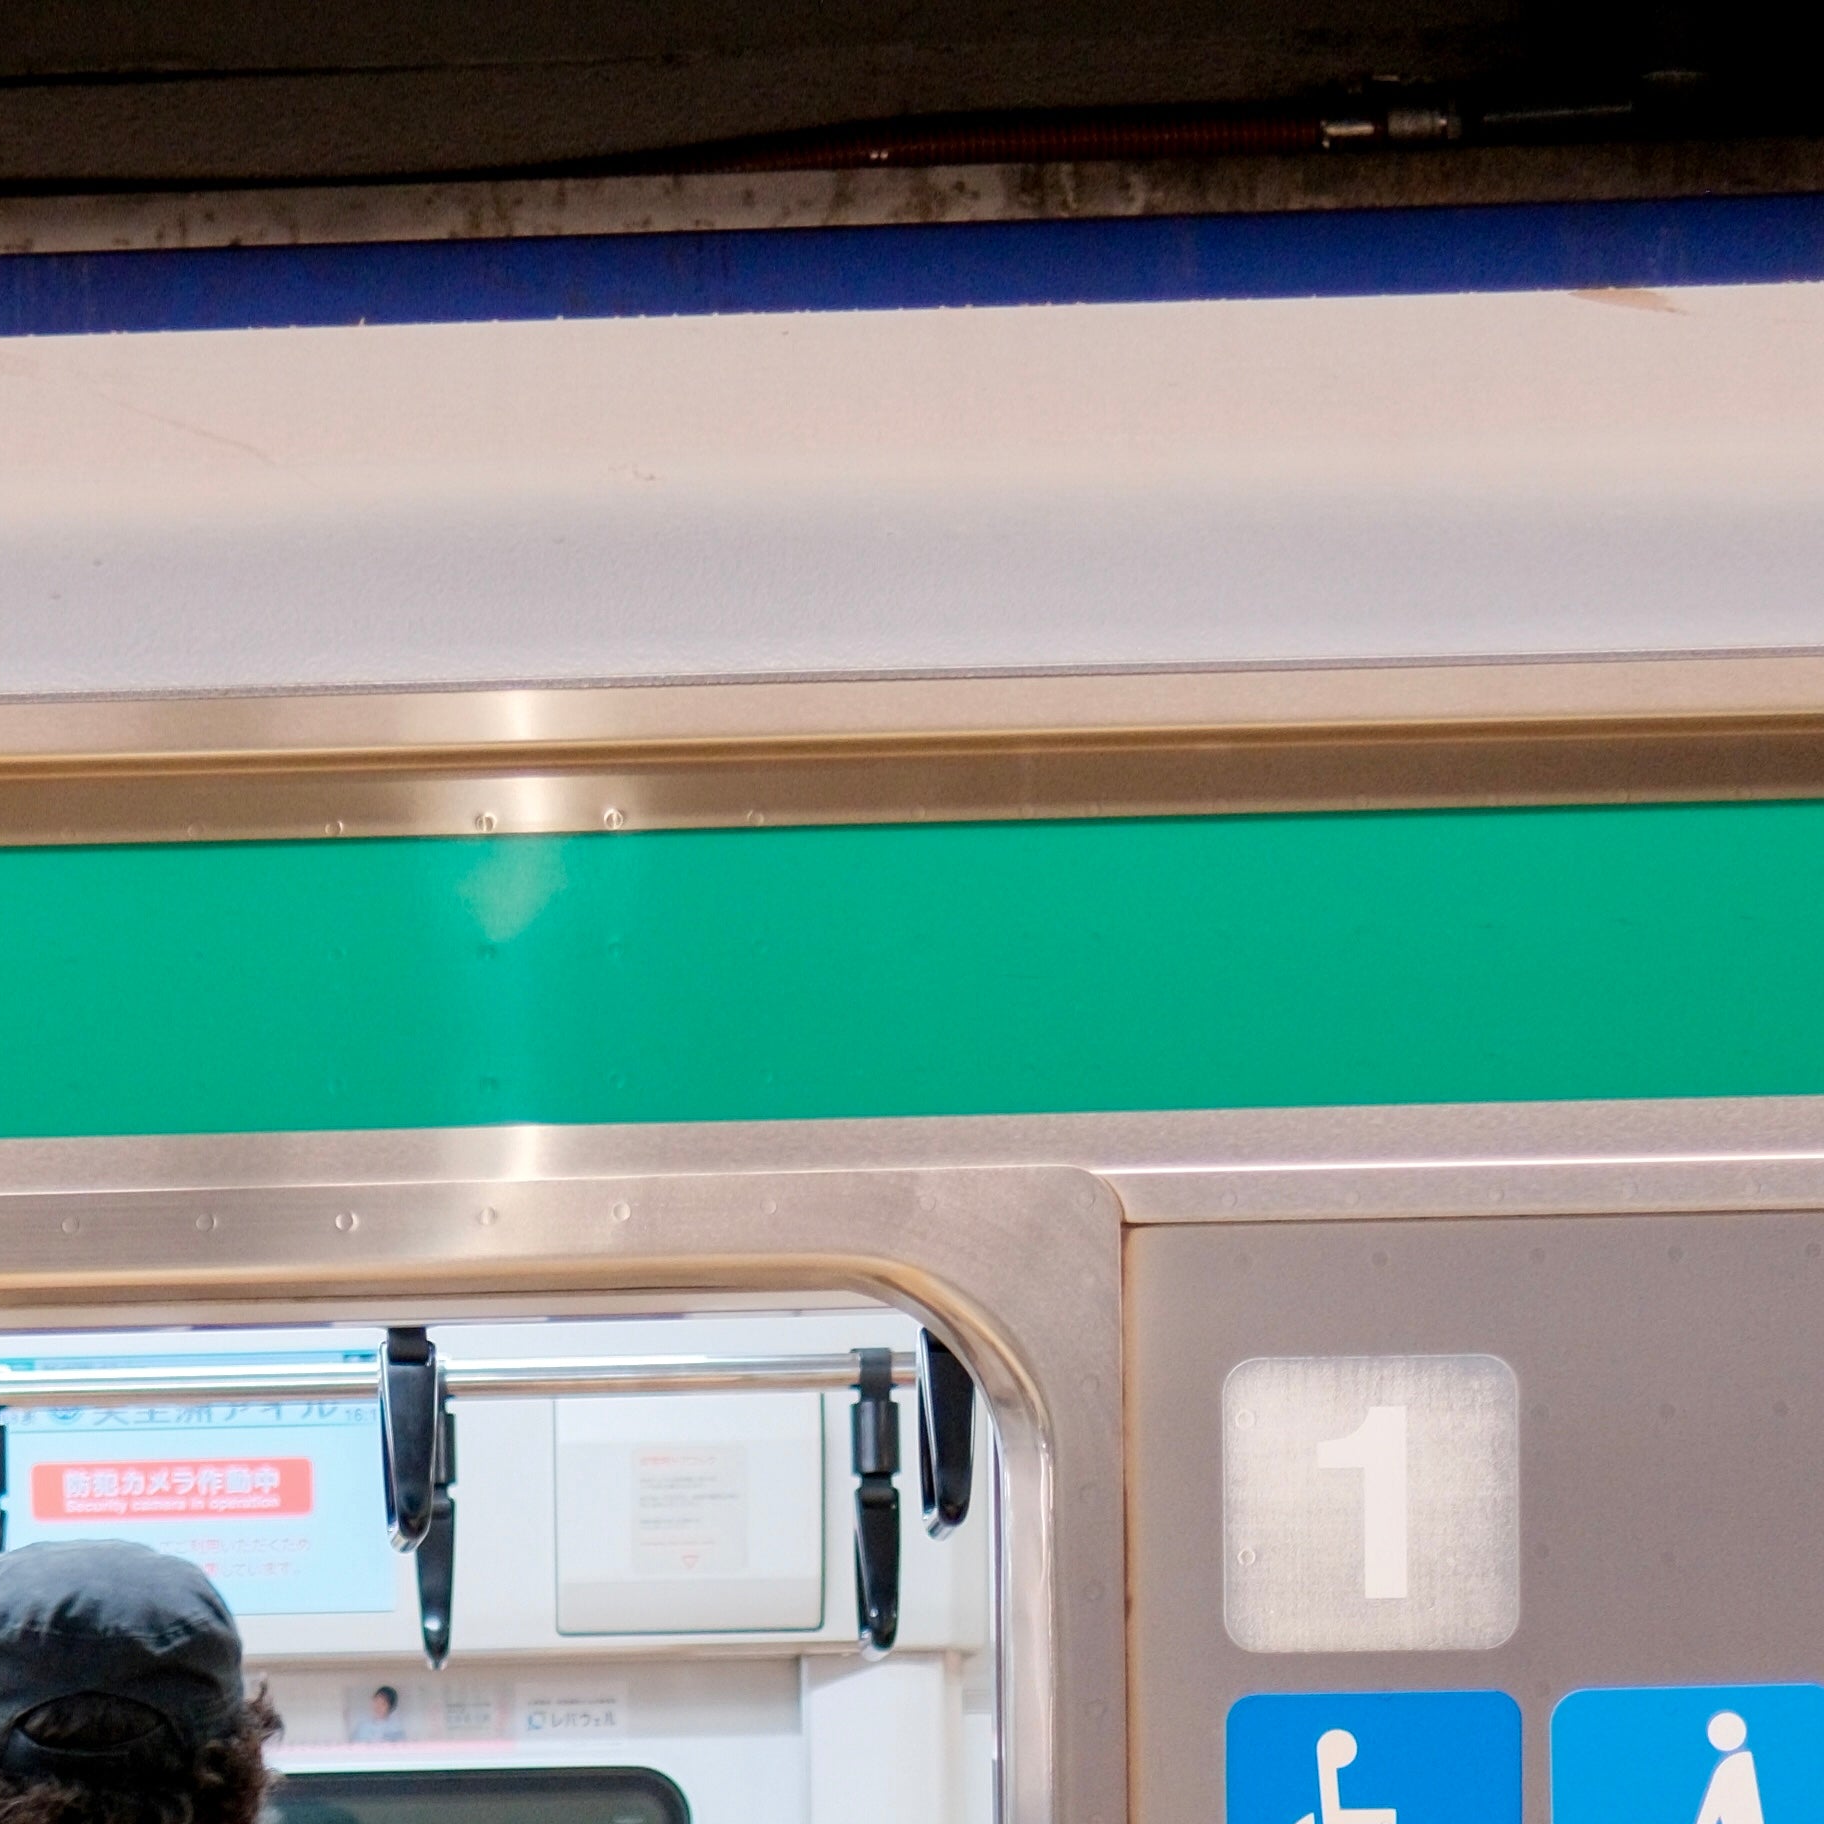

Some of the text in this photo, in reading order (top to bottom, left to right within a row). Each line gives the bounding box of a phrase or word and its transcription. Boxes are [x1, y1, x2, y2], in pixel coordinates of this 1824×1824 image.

[65, 1467, 280, 1497] 防犯カメラ作動中
[65, 1499, 127, 1514] Security
[1317, 1406, 1407, 1598] 1
